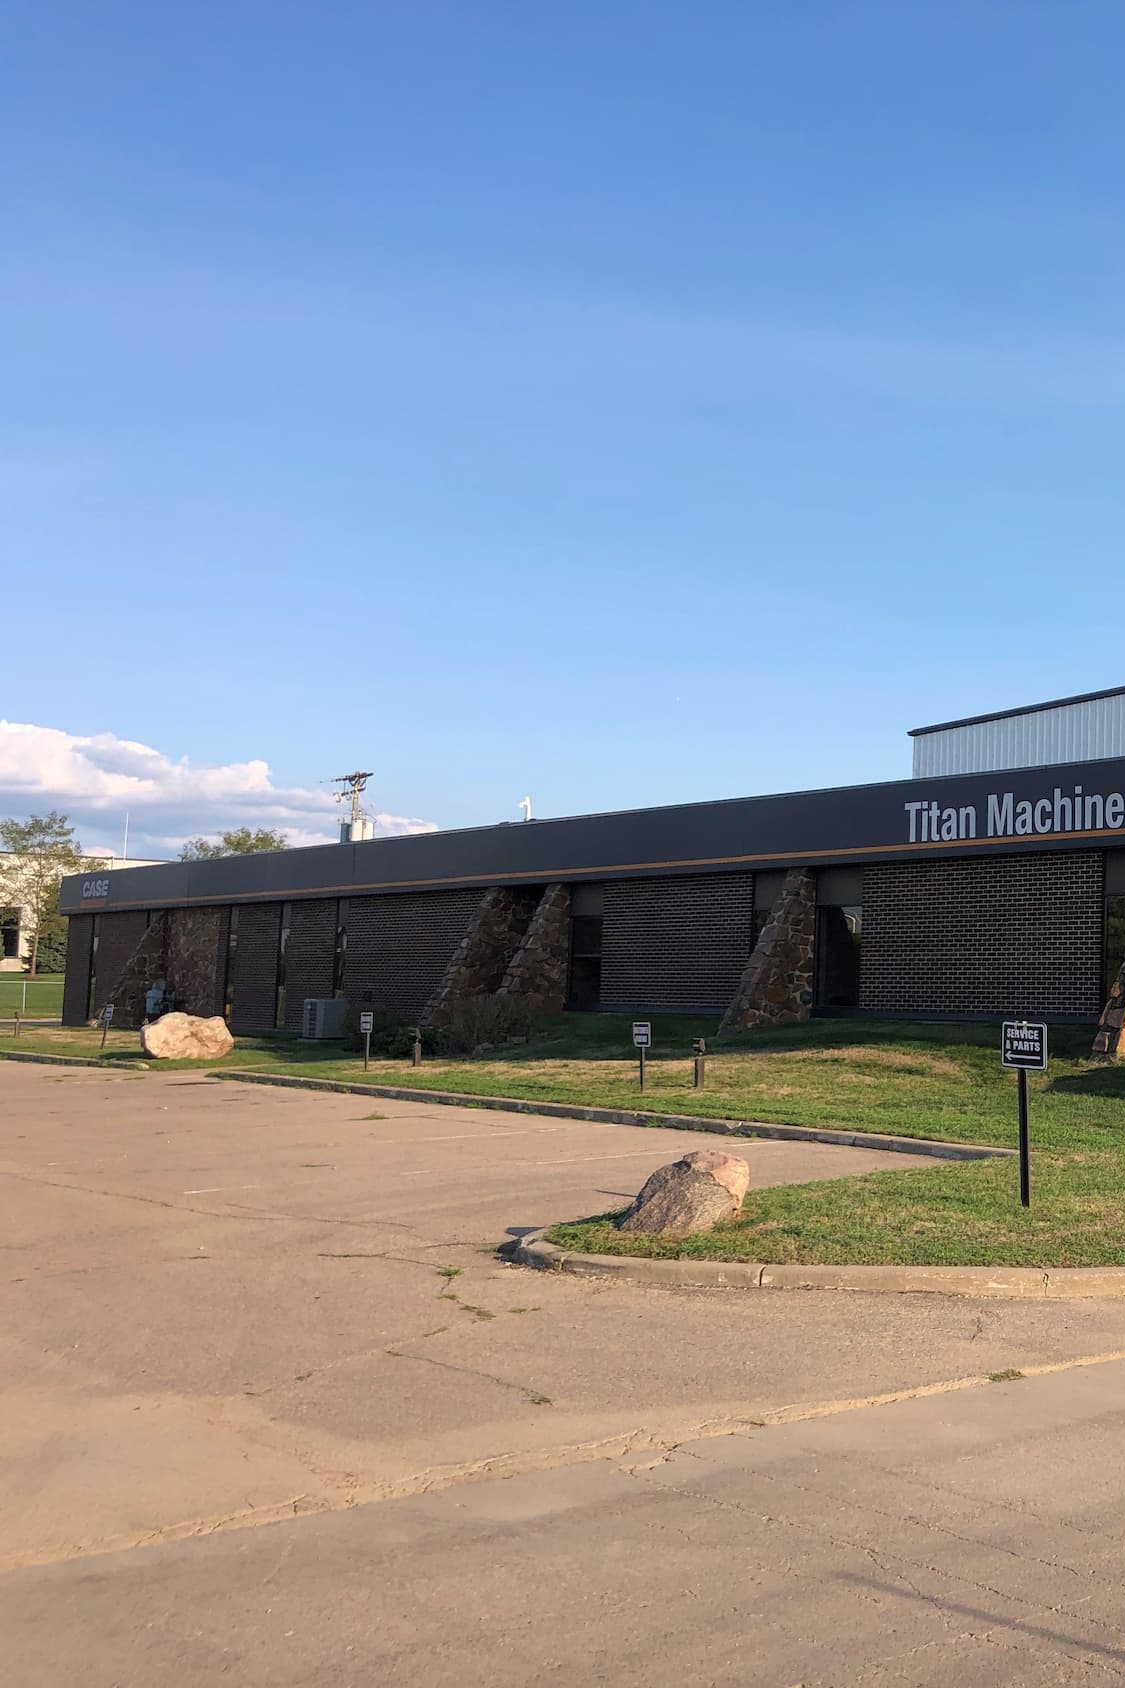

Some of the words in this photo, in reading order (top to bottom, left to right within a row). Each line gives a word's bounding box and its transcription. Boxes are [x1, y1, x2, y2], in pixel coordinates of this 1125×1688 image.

[905, 801, 976, 843] Titan
[83, 880, 109, 897] CASE
[1006, 1028, 1039, 1040] SERVICE
[1005, 1040, 1011, 1049] &
[1013, 1041, 1040, 1052] PARTS
